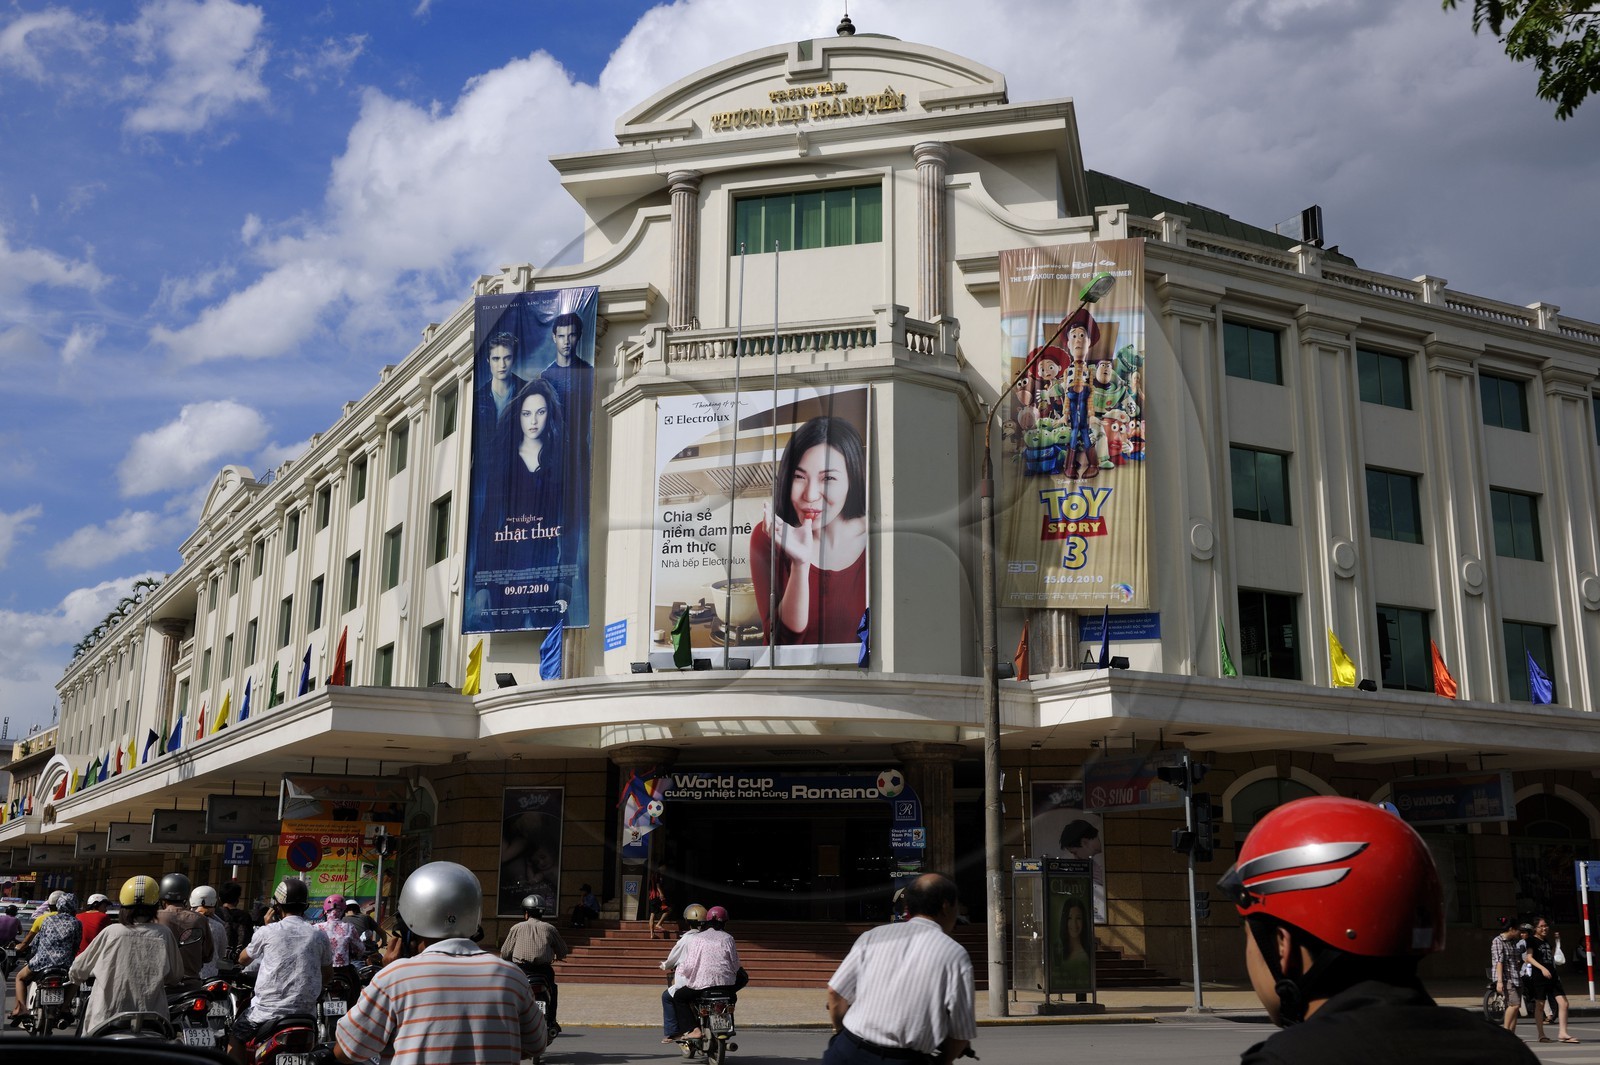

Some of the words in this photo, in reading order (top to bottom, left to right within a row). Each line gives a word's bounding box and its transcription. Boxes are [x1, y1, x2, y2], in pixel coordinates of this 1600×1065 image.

[768, 86, 815, 100] TRUNG
[817, 82, 847, 94] TÂM
[776, 106, 808, 124] MẠI
[866, 86, 906, 112] TIỀN
[1023, 274, 1054, 282] BREAKOUT
[676, 412, 730, 424] Electrolux
[1039, 486, 1113, 522] TOY
[663, 510, 692, 522] Chia
[696, 508, 712, 521] sẻ
[494, 525, 528, 542] nhật
[531, 522, 563, 540] thực
[663, 524, 695, 538] niềm
[699, 525, 727, 536] đam
[730, 522, 752, 535] mê
[1048, 522, 1101, 532] STORY
[662, 540, 682, 554] ẩm
[687, 542, 716, 554] thực
[1062, 534, 1088, 570] 3
[662, 560, 680, 568] Nhà
[682, 558, 699, 568] bếp
[1008, 562, 1040, 573] 3D
[1044, 575, 1104, 584] 25.06.2010
[504, 584, 549, 595] 09.07.2010
[481, 608, 560, 616] MEGASTAR
[674, 775, 734, 788] World
[738, 778, 774, 791] cup
[664, 788, 702, 799] cuồng
[704, 788, 735, 799] nhiệt
[737, 788, 760, 798] hơn
[762, 789, 788, 799] cùng
[792, 785, 879, 799] Romano
[1109, 789, 1134, 804] SINO
[1413, 795, 1456, 806] VANLOCK
[232, 843, 245, 858] P
